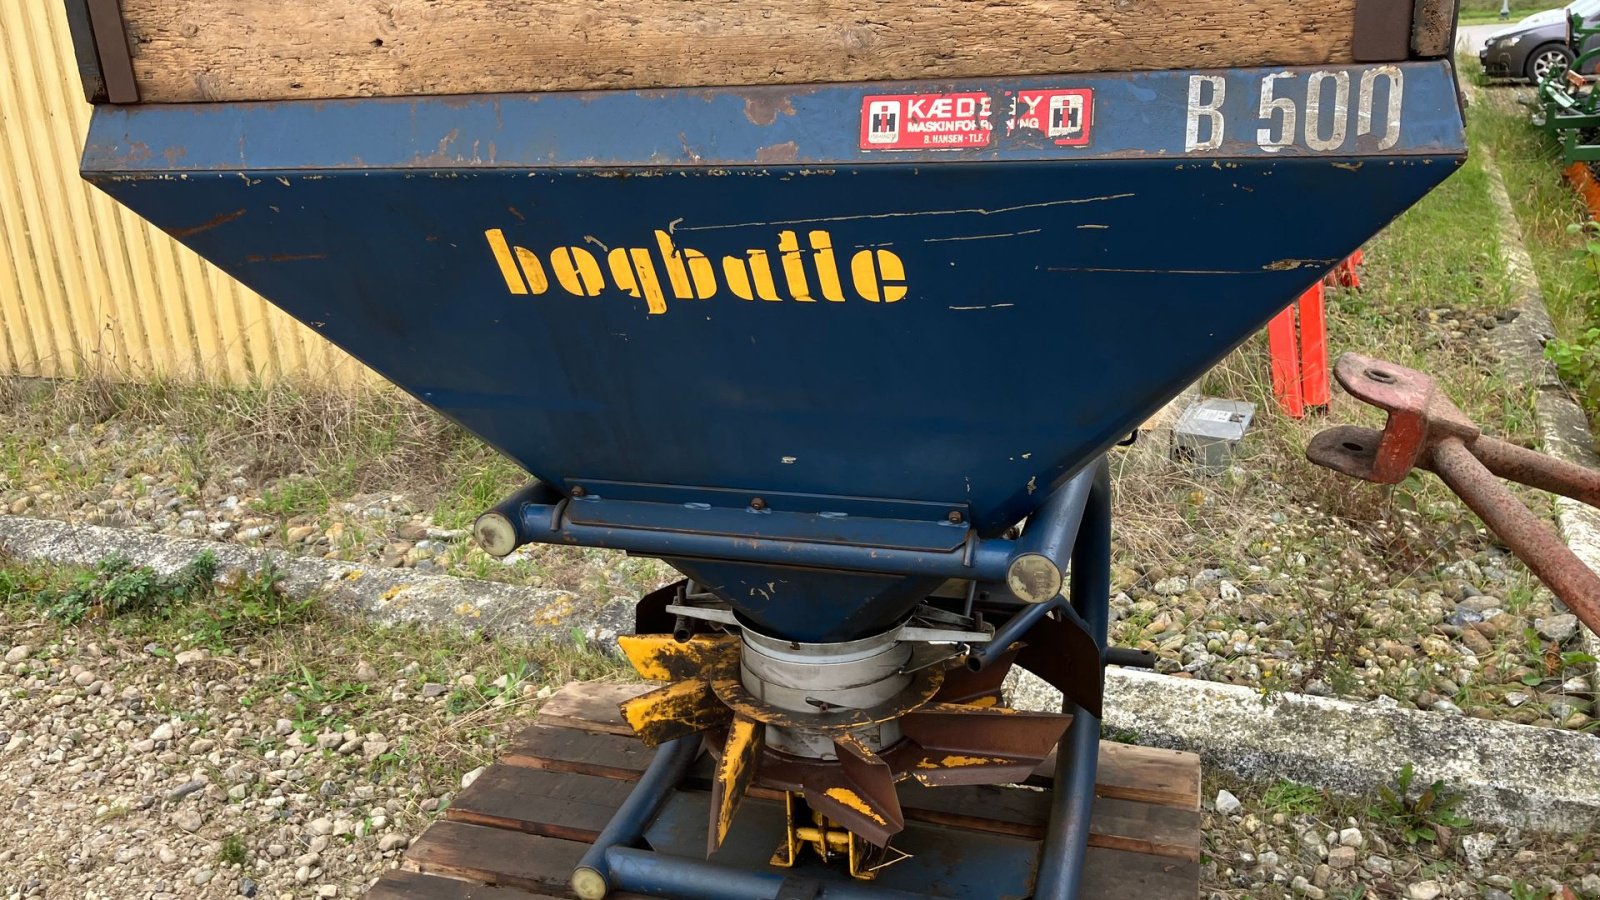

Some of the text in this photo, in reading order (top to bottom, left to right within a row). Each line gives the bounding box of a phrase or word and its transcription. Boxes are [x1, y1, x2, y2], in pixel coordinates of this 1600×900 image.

[1185, 64, 1404, 153] B 500
[932, 134, 963, 143] HANSEN
